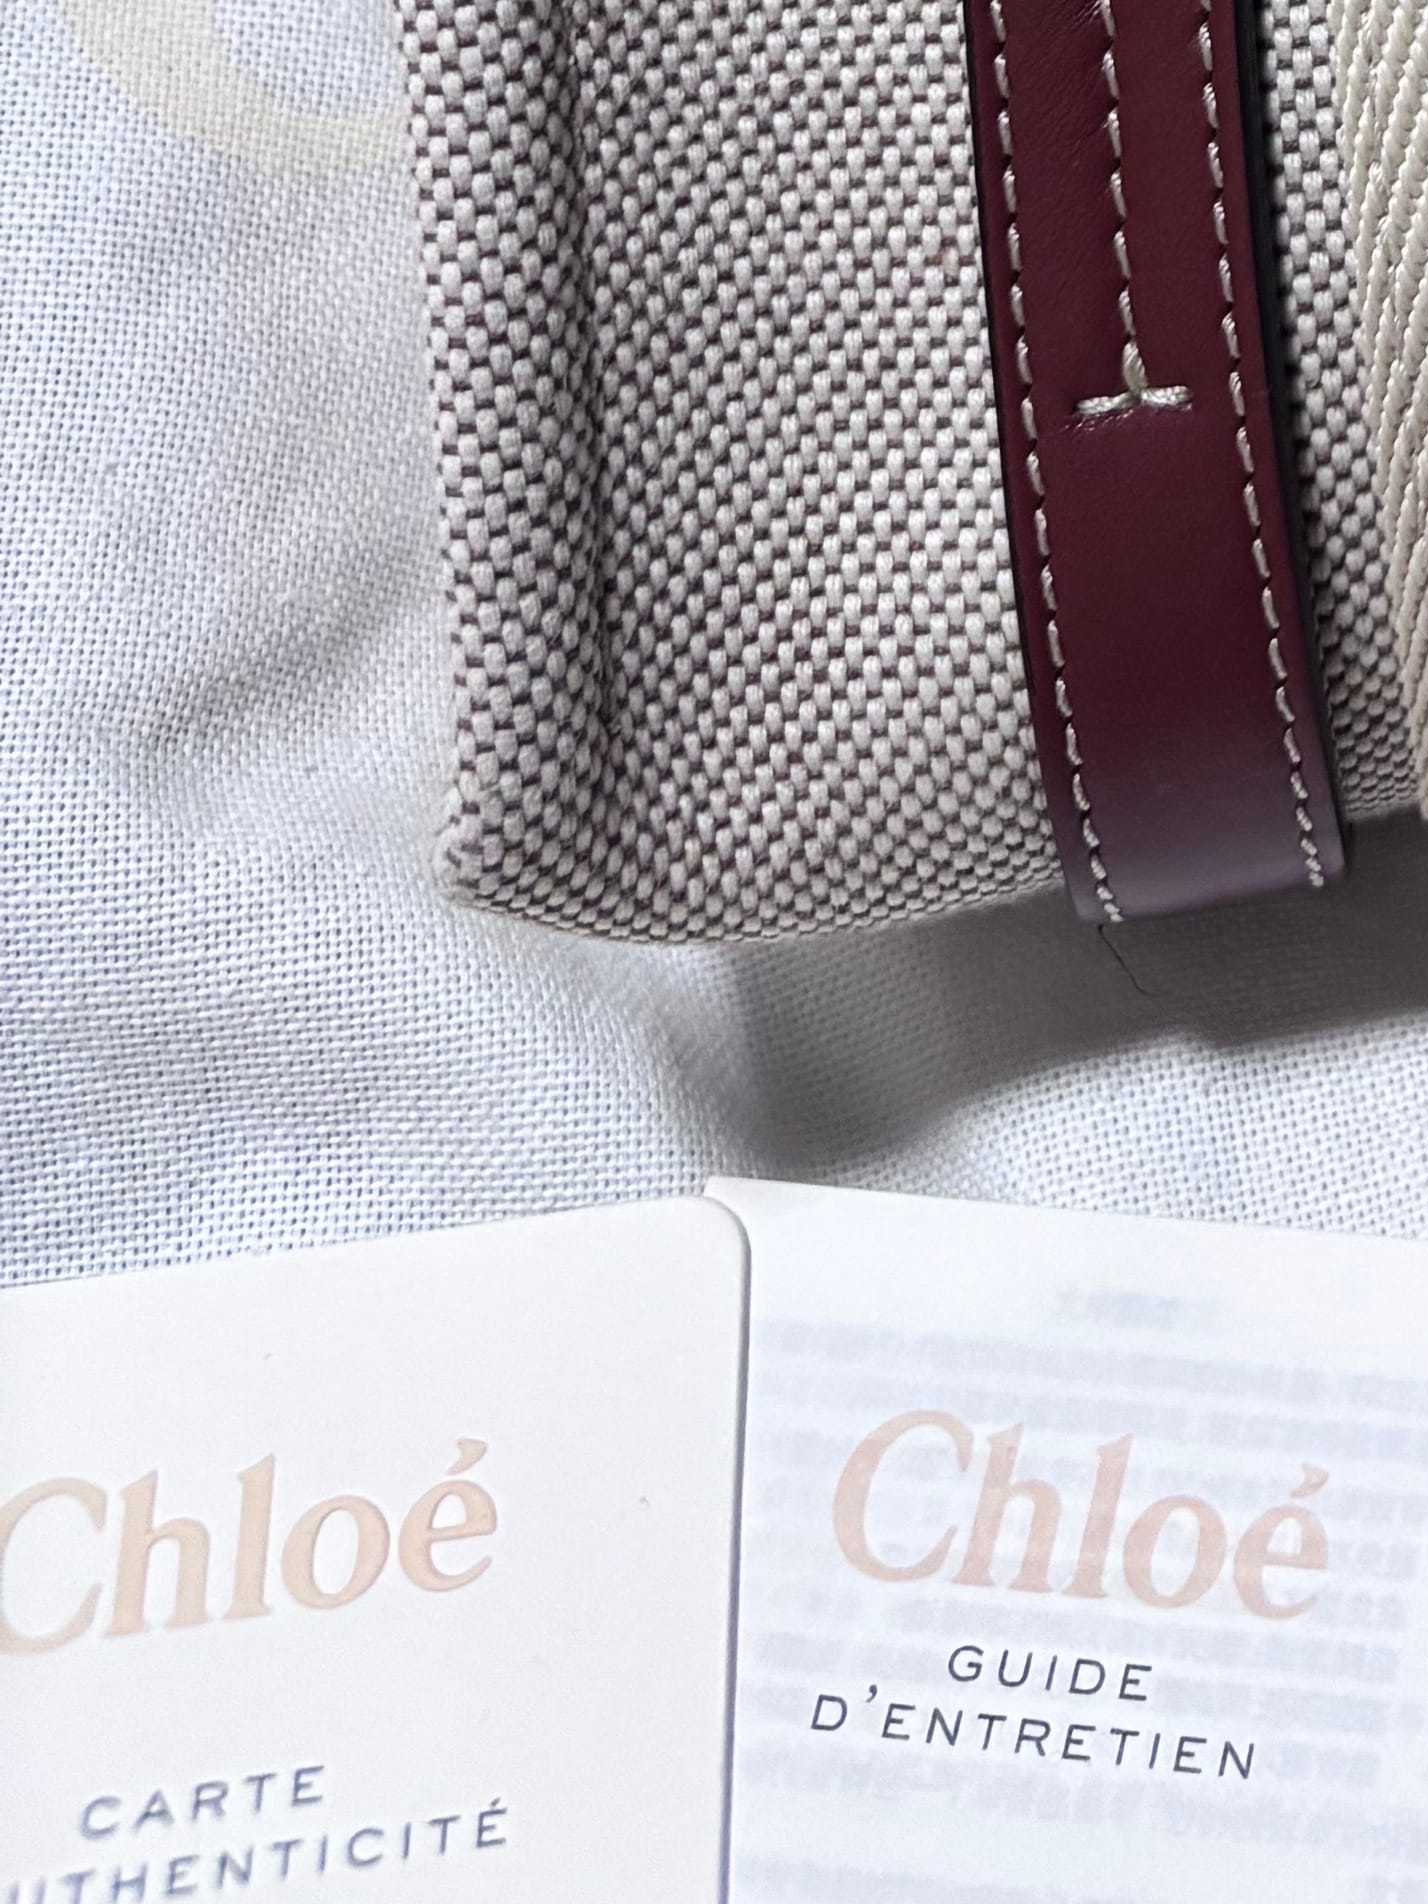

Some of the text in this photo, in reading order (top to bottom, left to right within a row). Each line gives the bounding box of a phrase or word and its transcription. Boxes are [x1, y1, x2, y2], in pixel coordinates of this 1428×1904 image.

[0, 1437, 498, 1656] Chloé
[832, 1408, 1331, 1621] Chloé
[947, 1644, 1154, 1702] GUIDE
[809, 1683, 1257, 1780] D'ENTRETIEN
[80, 1764, 326, 1842] CARTE
